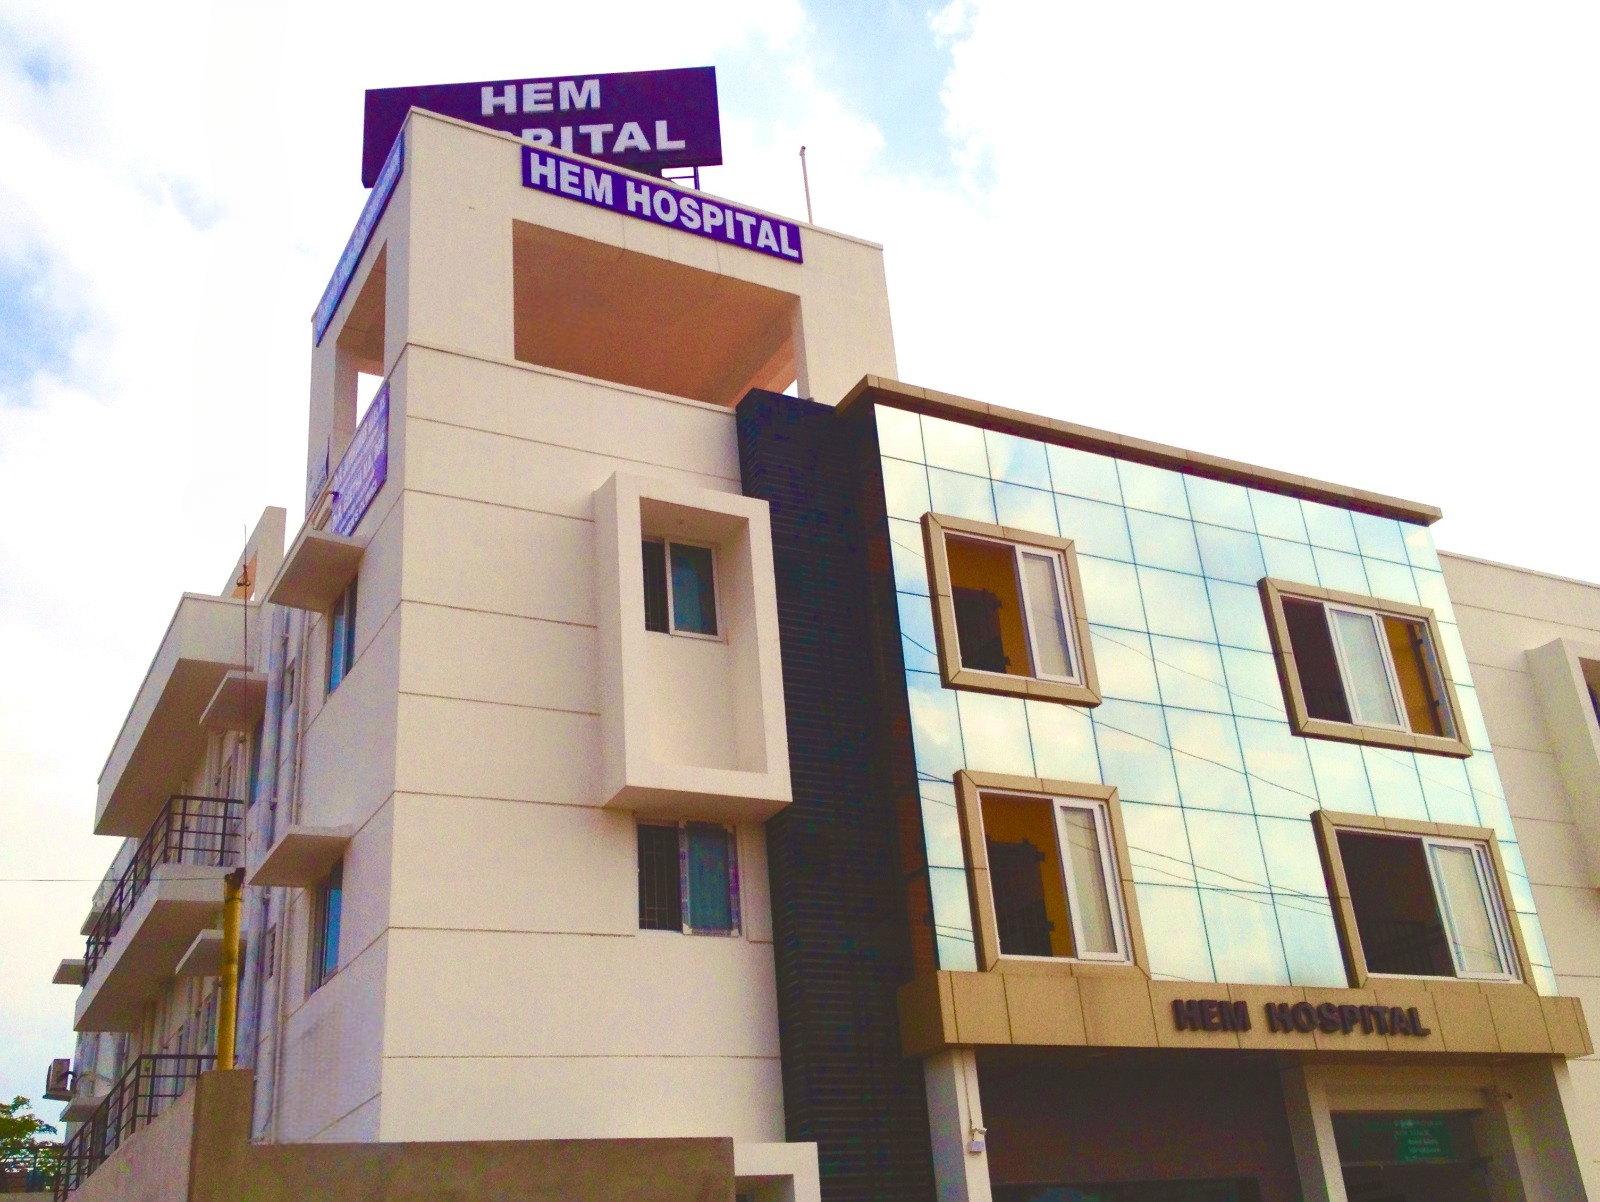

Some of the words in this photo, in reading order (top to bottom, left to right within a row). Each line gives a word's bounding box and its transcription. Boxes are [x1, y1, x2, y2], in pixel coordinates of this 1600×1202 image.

[481, 79, 600, 115] HEM
[499, 120, 686, 154] PITAL
[530, 152, 613, 205] HEM
[626, 180, 799, 258] HOSPITAL
[1172, 1000, 1251, 1032] HEM
[1265, 1001, 1431, 1036] HOSPITAL
